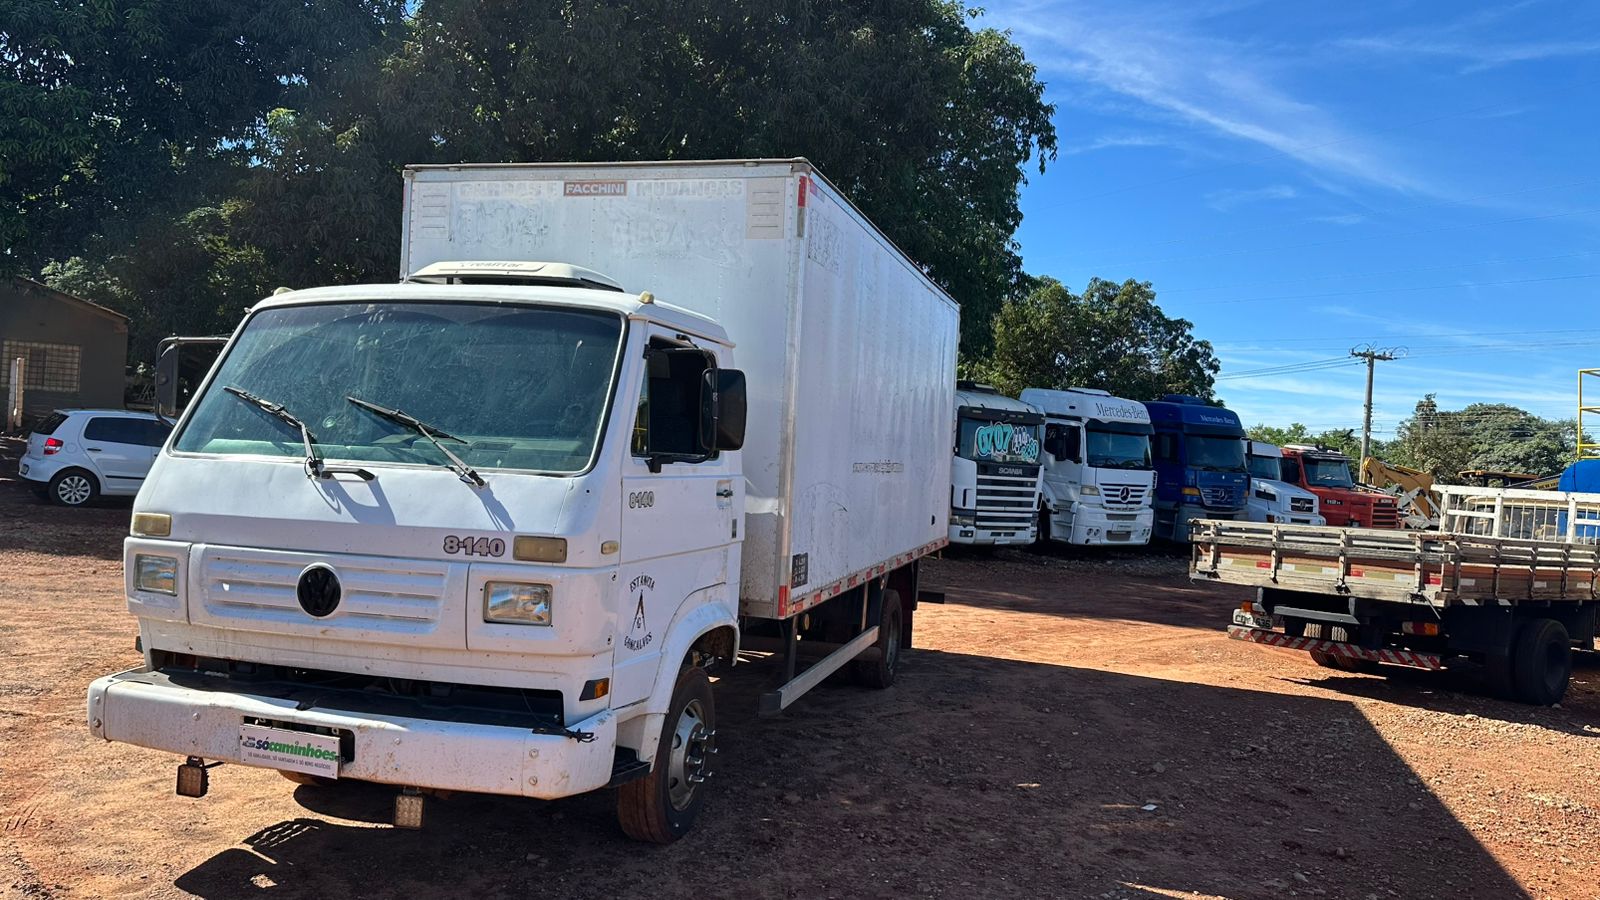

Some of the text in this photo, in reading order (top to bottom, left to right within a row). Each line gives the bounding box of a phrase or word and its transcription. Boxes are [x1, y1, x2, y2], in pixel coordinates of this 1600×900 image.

[566, 183, 624, 194] FACCHINI
[998, 467, 1023, 475] SCANIA
[629, 491, 655, 509] 8-140
[443, 536, 505, 557] 8-140
